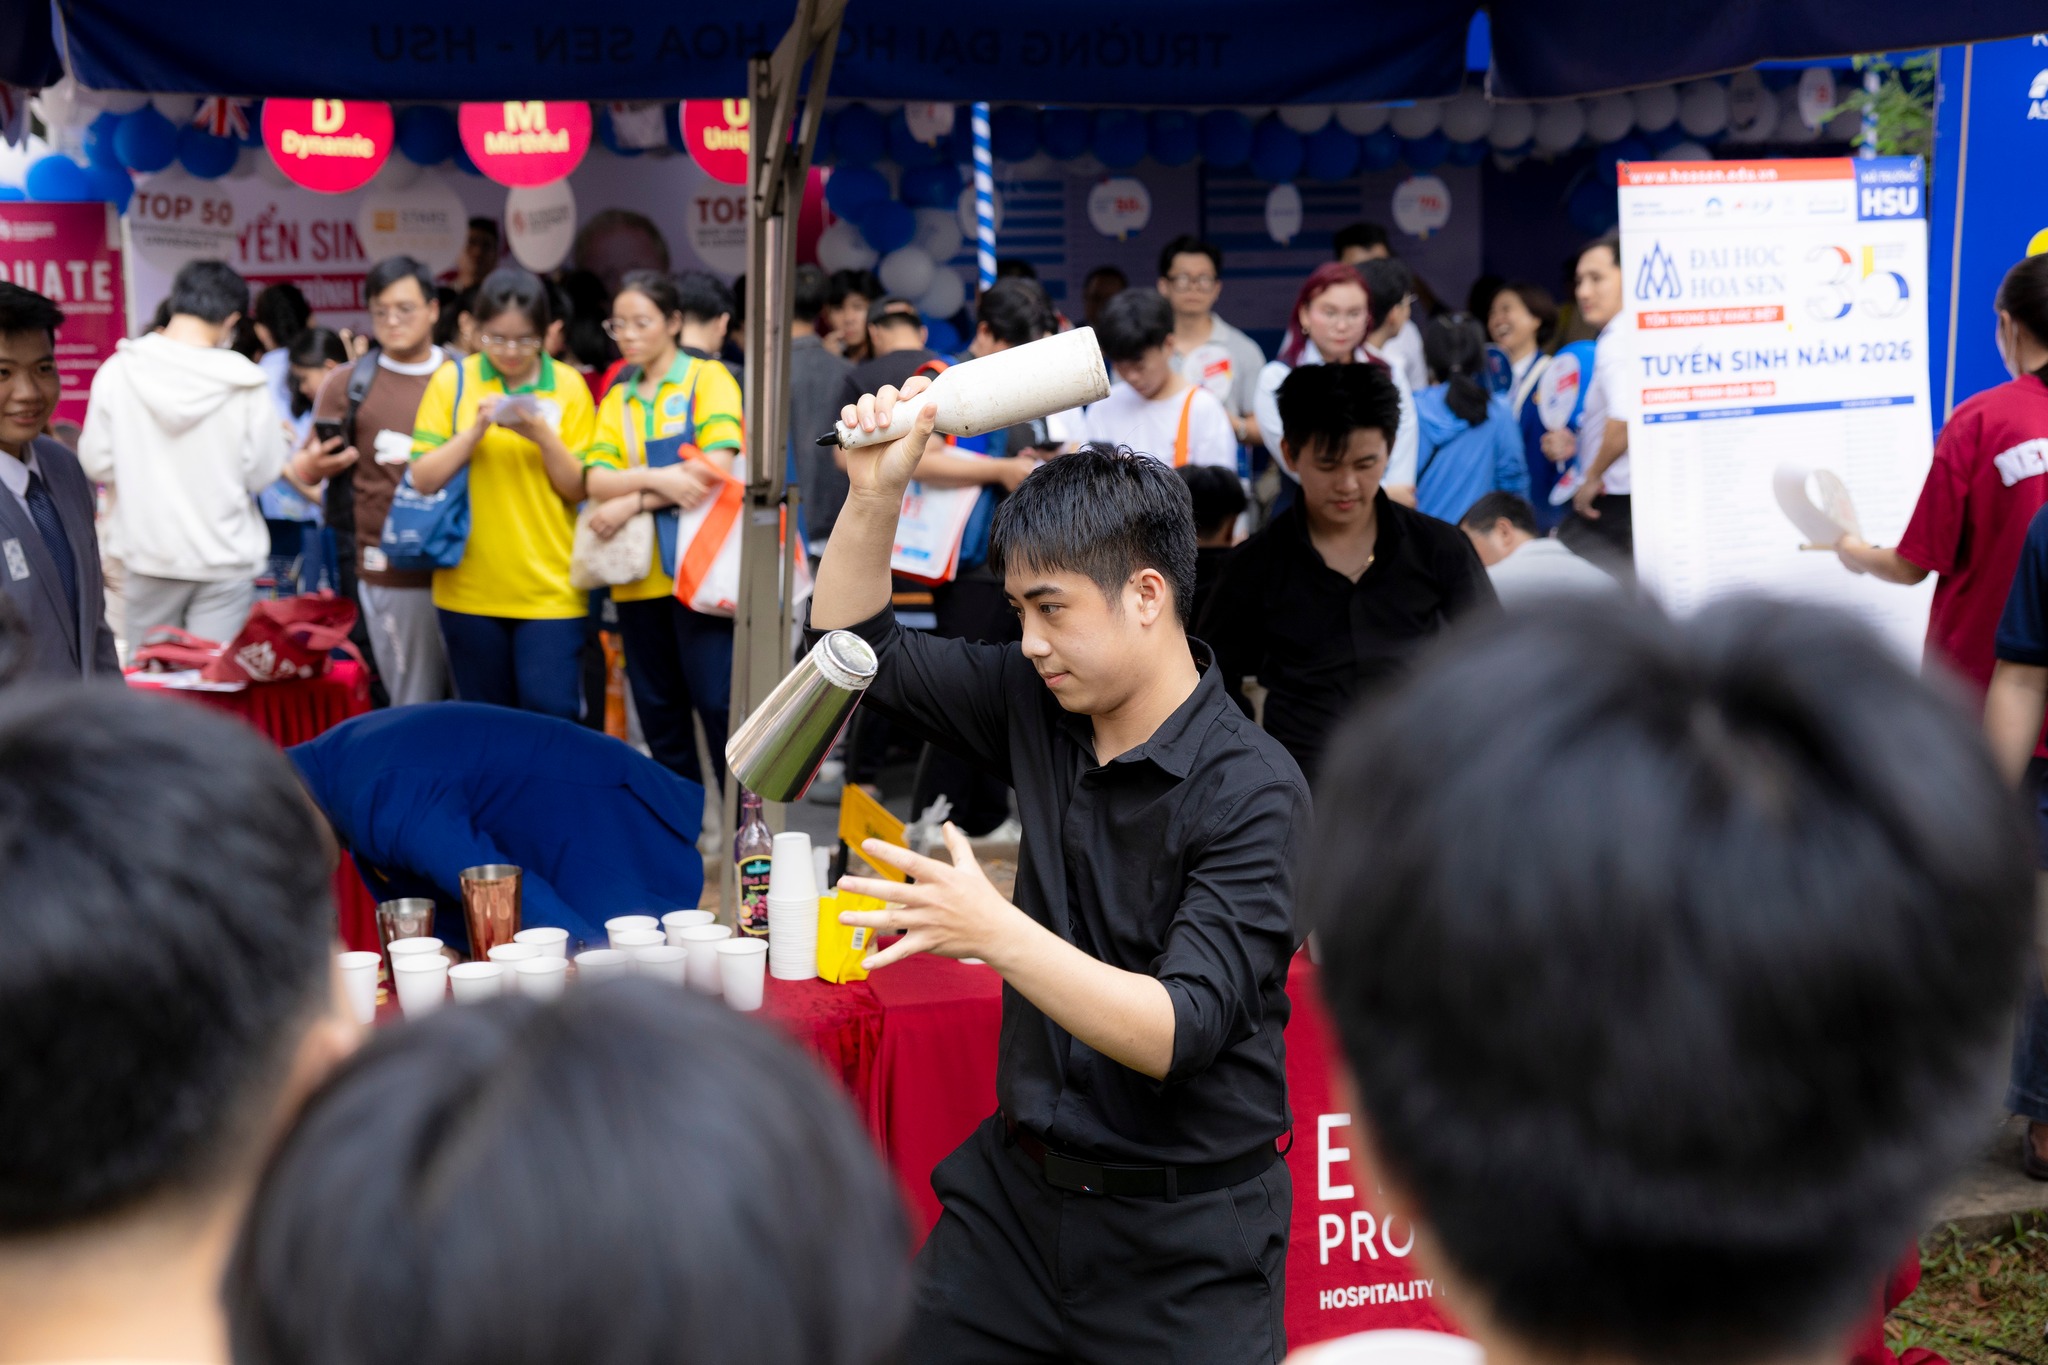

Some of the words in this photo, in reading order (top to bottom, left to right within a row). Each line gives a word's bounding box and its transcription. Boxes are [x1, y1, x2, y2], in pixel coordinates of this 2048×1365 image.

[312, 98, 346, 134] D
[503, 100, 548, 132] M
[281, 129, 376, 160] Dynamic
[484, 128, 570, 155] Mirthful
[703, 126, 750, 155] Uniq
[137, 193, 193, 221] TOP
[202, 201, 233, 226] 50
[1862, 187, 1919, 216] HSU
[311, 219, 366, 262] SIN
[1689, 276, 1741, 299] HOA
[1744, 272, 1788, 297] SEN
[1732, 348, 1788, 372] SINH
[1798, 340, 1851, 367] NĂM
[1860, 340, 1912, 363] 2026
[1318, 1113, 1355, 1201] E
[1319, 1210, 1416, 1265] PRO
[1319, 1279, 1434, 1310] HOSPITALITY
